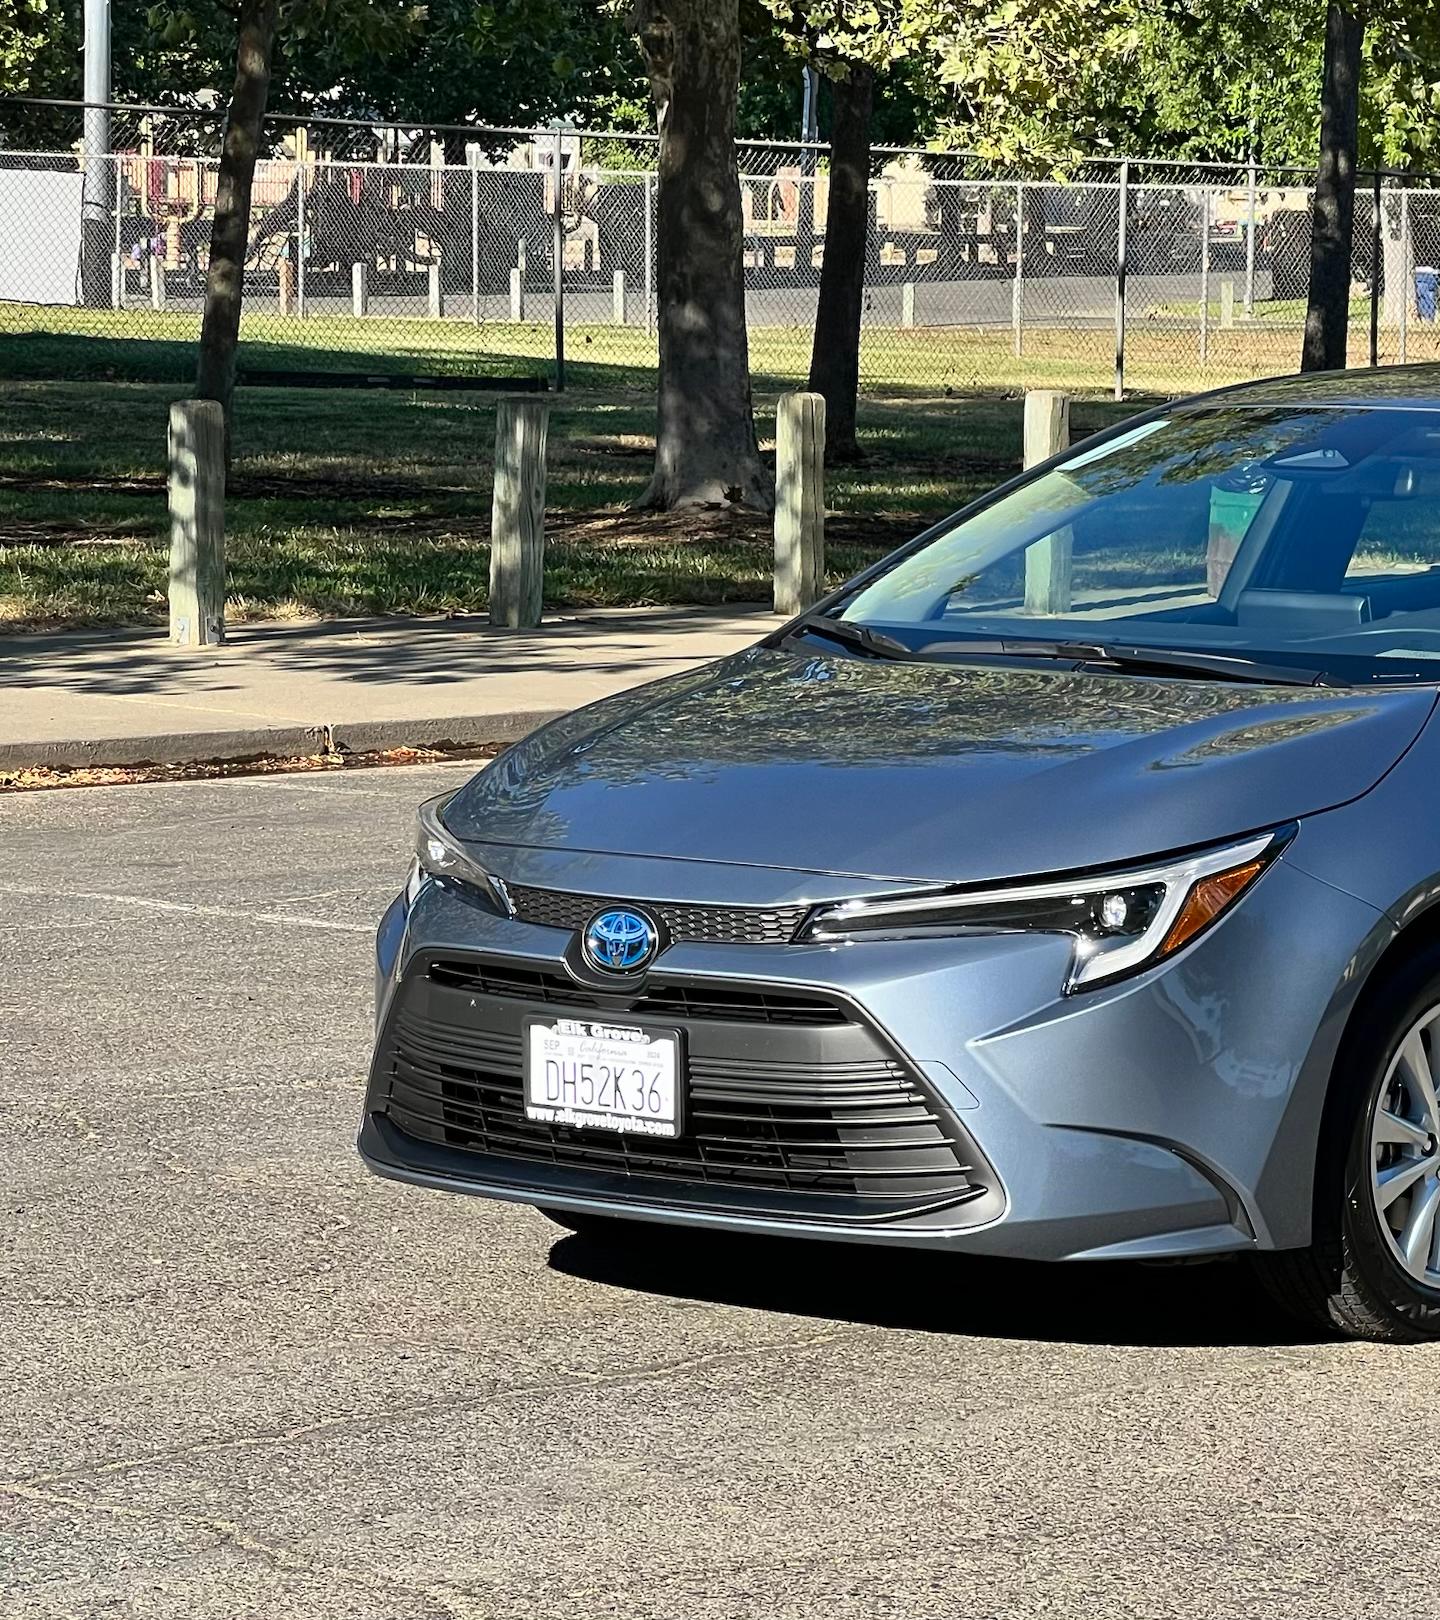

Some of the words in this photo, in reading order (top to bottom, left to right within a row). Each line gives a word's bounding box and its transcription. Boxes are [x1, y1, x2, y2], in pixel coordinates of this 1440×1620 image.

[558, 1021, 587, 1037] Elk
[591, 1025, 642, 1042] Grove
[543, 1039, 560, 1050] SEP
[579, 1040, 628, 1059] California
[545, 1059, 662, 1113] DH52K36
[526, 1106, 675, 1136] www.elkgrovetoyota.com
